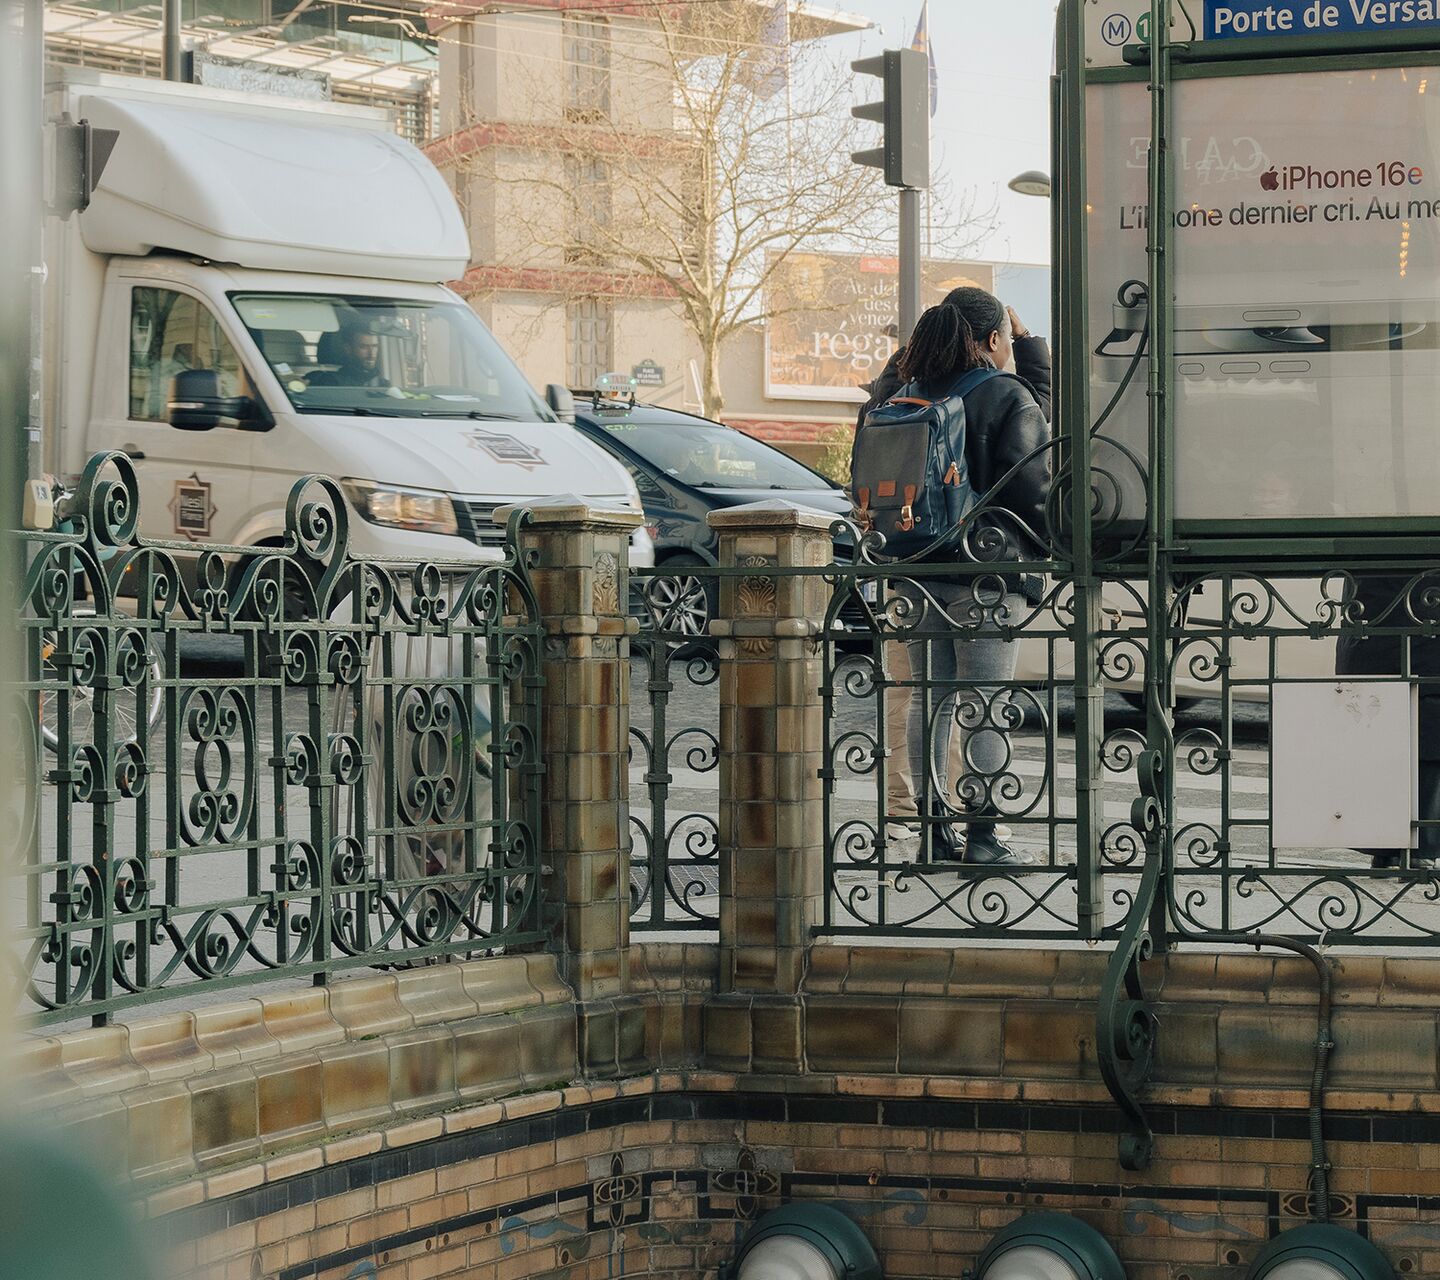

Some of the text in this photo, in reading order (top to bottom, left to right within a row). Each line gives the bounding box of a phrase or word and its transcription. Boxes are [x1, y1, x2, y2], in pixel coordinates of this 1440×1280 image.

[1138, 18, 1151, 38] 1
[1215, 6, 1293, 34] Porte
[1303, 0, 1339, 28] de
[1282, 161, 1423, 191] iPhone 16e
[1120, 205, 1223, 230] L'ione
[1229, 200, 1318, 226] dernier
[1323, 197, 1361, 222] cri.
[1366, 195, 1400, 221] Au
